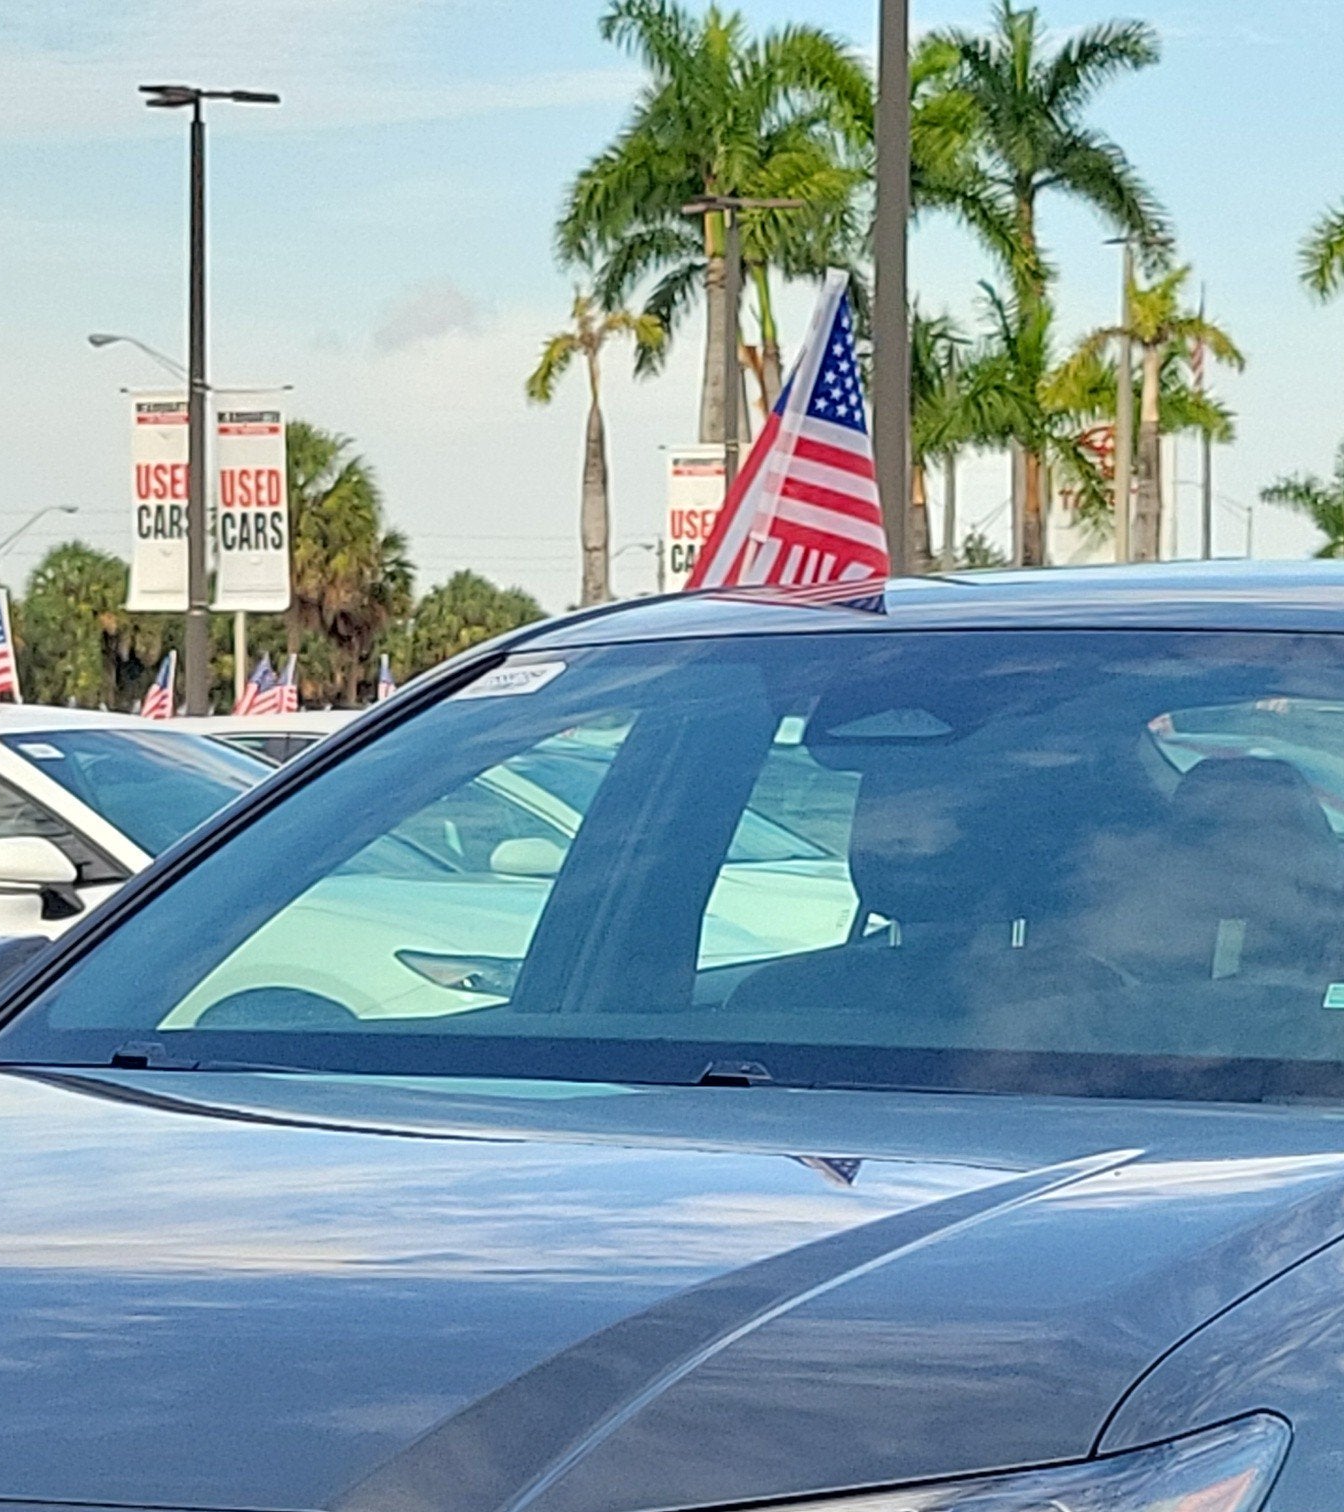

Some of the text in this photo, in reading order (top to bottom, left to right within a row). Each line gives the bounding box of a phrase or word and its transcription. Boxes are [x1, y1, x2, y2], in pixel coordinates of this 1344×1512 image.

[220, 469, 281, 507] USED
[221, 511, 283, 550] CARS
[671, 510, 721, 539] USE
